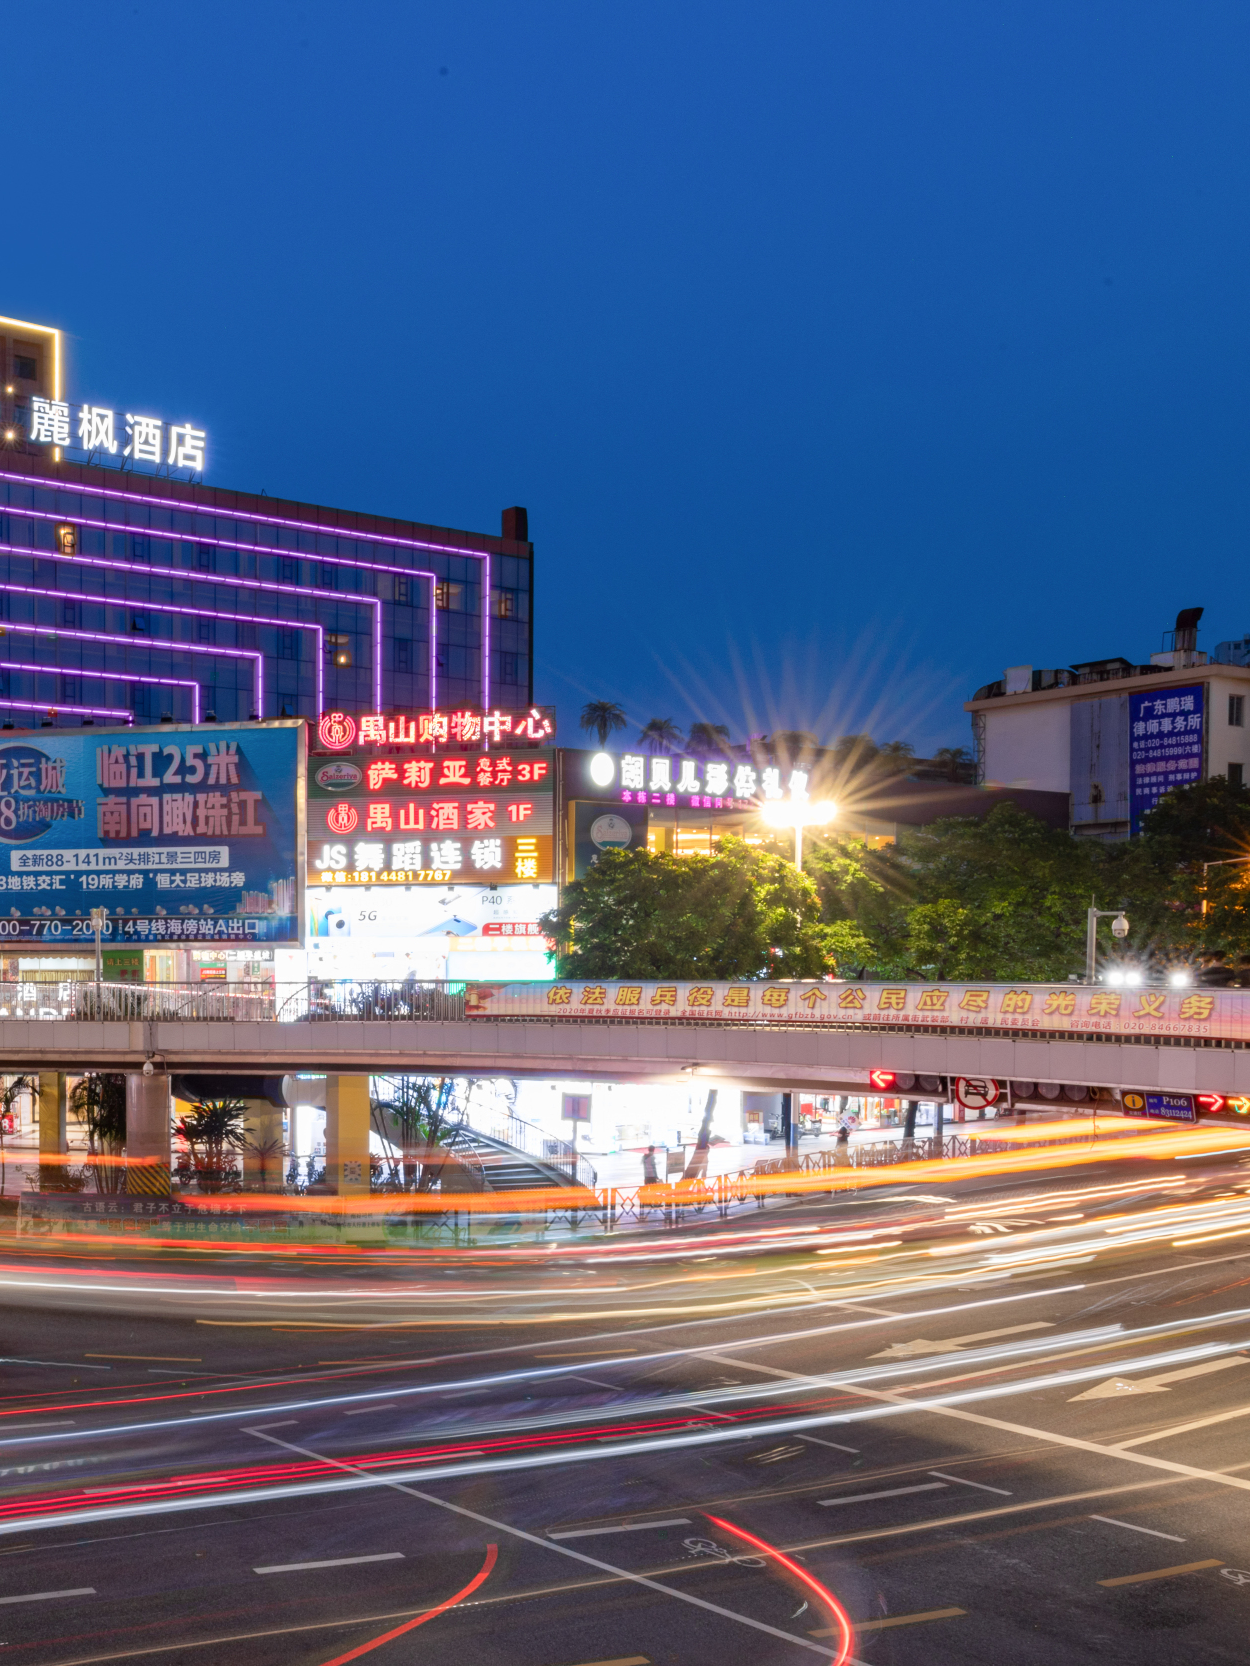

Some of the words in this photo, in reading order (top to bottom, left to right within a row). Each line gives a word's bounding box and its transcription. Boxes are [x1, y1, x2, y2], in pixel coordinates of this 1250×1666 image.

[30, 395, 207, 472] 麗枫酒店
[1140, 695, 1194, 717] 广东鹏瑞
[358, 708, 552, 745] 禺山购物中心
[1133, 714, 1201, 737] 律师事务所
[96, 741, 239, 788] 临江25米
[517, 762, 547, 781] 3F
[1135, 757, 1199, 774] 法律服务范围
[368, 760, 471, 790] 萨莉亚
[96, 791, 264, 839] 南向瞰珠江
[367, 801, 496, 831] 禺山酒家
[507, 804, 533, 822] 1F
[315, 845, 347, 870] JS
[354, 839, 502, 871] 舞蹈连锁
[514, 838, 539, 879] 三楼
[79, 873, 144, 890] 19所学府
[156, 871, 246, 889] 恒大足球场旁
[380, 870, 414, 882] 4481
[417, 870, 452, 881] 7767
[482, 895, 502, 906] P40
[358, 910, 378, 921] 5G
[124, 918, 260, 935] 4号线海傍站A出口
[488, 923, 550, 935] 二楼旗舰
[547, 986, 1214, 1020] 依法服兵役是每个公民应尽的光荣义务
[1162, 1096, 1188, 1107] P106
[1160, 1107, 1192, 1119] 83112424
